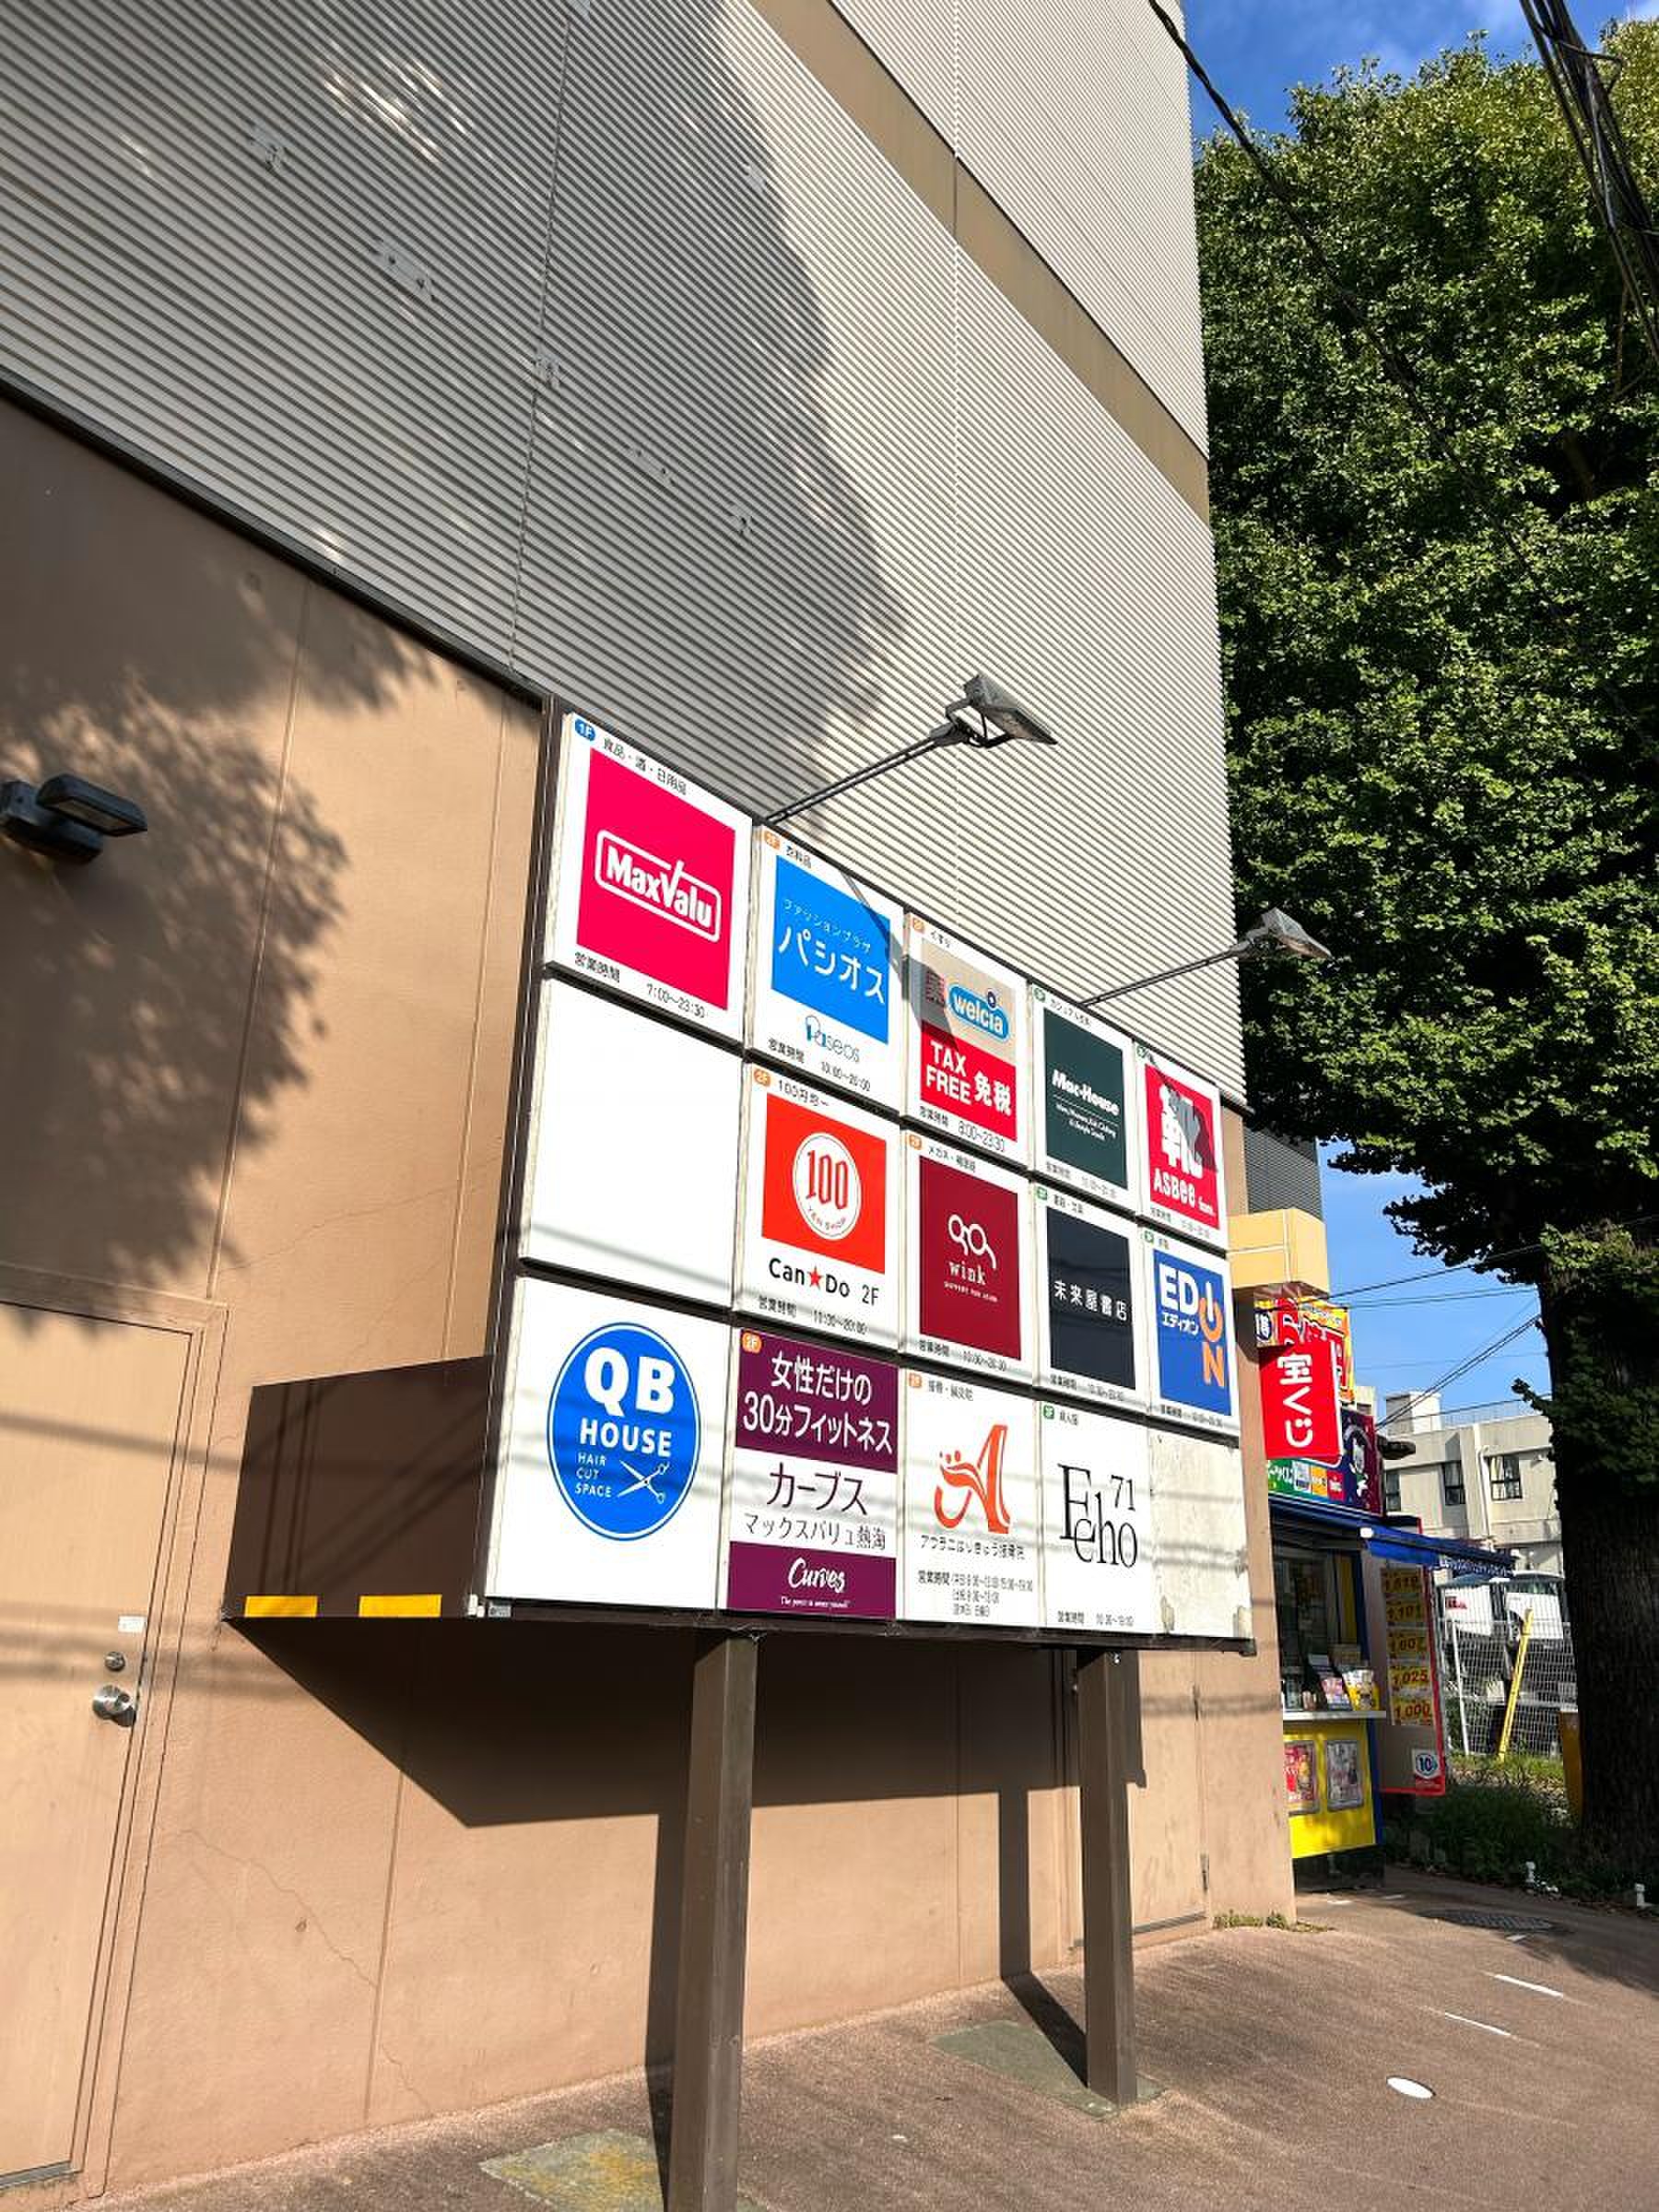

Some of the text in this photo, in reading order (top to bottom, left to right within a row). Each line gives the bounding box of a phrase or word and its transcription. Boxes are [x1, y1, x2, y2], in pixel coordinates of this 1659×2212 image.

[606, 845, 712, 928] MaxValu
[574, 950, 620, 982] 営業時間
[778, 924, 886, 1006] パシオス
[952, 990, 1005, 1036] welcia
[929, 1040, 967, 1077] TAX
[925, 1064, 972, 1106] FREE
[973, 1069, 1012, 1117] 免税
[806, 1149, 849, 1210] 100
[1153, 1167, 1196, 1208] ASBee
[769, 1257, 879, 1307] Can Do 2F
[1053, 1279, 1127, 1321] 未来屋書店
[583, 1347, 677, 1418] QB
[771, 1350, 872, 1406] 女性だけの
[1277, 1352, 1313, 1448] 宝くじ
[580, 1417, 672, 1458] HOUSE
[743, 1391, 893, 1454] 30分フィットネス
[576, 1467, 600, 1481] CUT
[578, 1452, 606, 1467] HAIR
[574, 1482, 612, 1499] SPACE
[767, 1462, 867, 1515] カーブス
[1111, 1474, 1136, 1512] 71
[744, 1512, 886, 1551] マックスバリュ熱海
[1056, 1463, 1138, 1569] Echo
[787, 1558, 845, 1593] Curves
